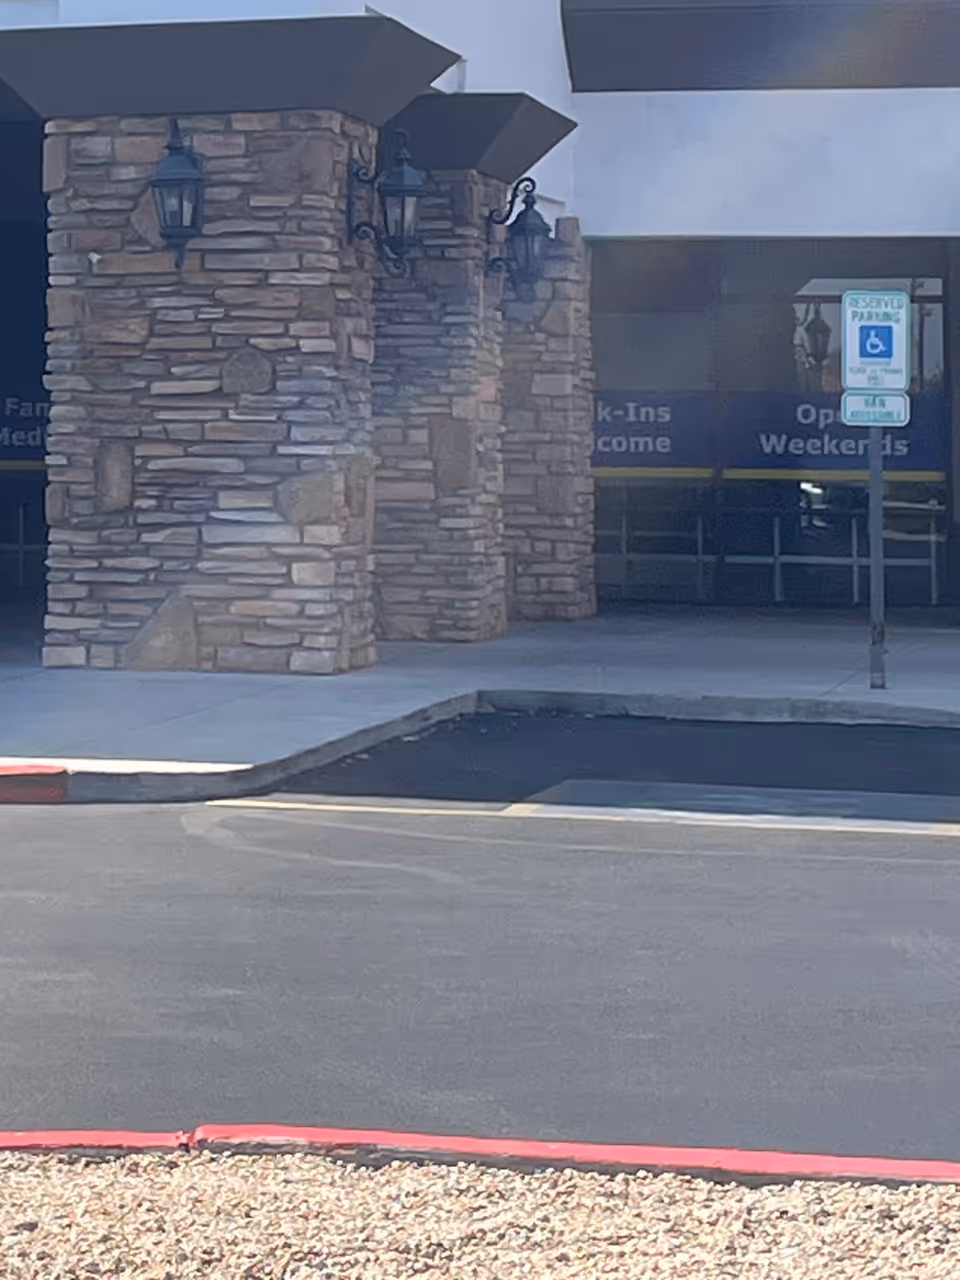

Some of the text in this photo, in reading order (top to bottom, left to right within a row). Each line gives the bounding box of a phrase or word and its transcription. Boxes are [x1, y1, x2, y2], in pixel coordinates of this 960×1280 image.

[848, 296, 905, 310] RESERVED
[851, 310, 901, 323] PARKING
[863, 396, 887, 409] VAN
[597, 400, 672, 423] k-Ins
[796, 403, 842, 430] Op
[597, 435, 672, 454] come
